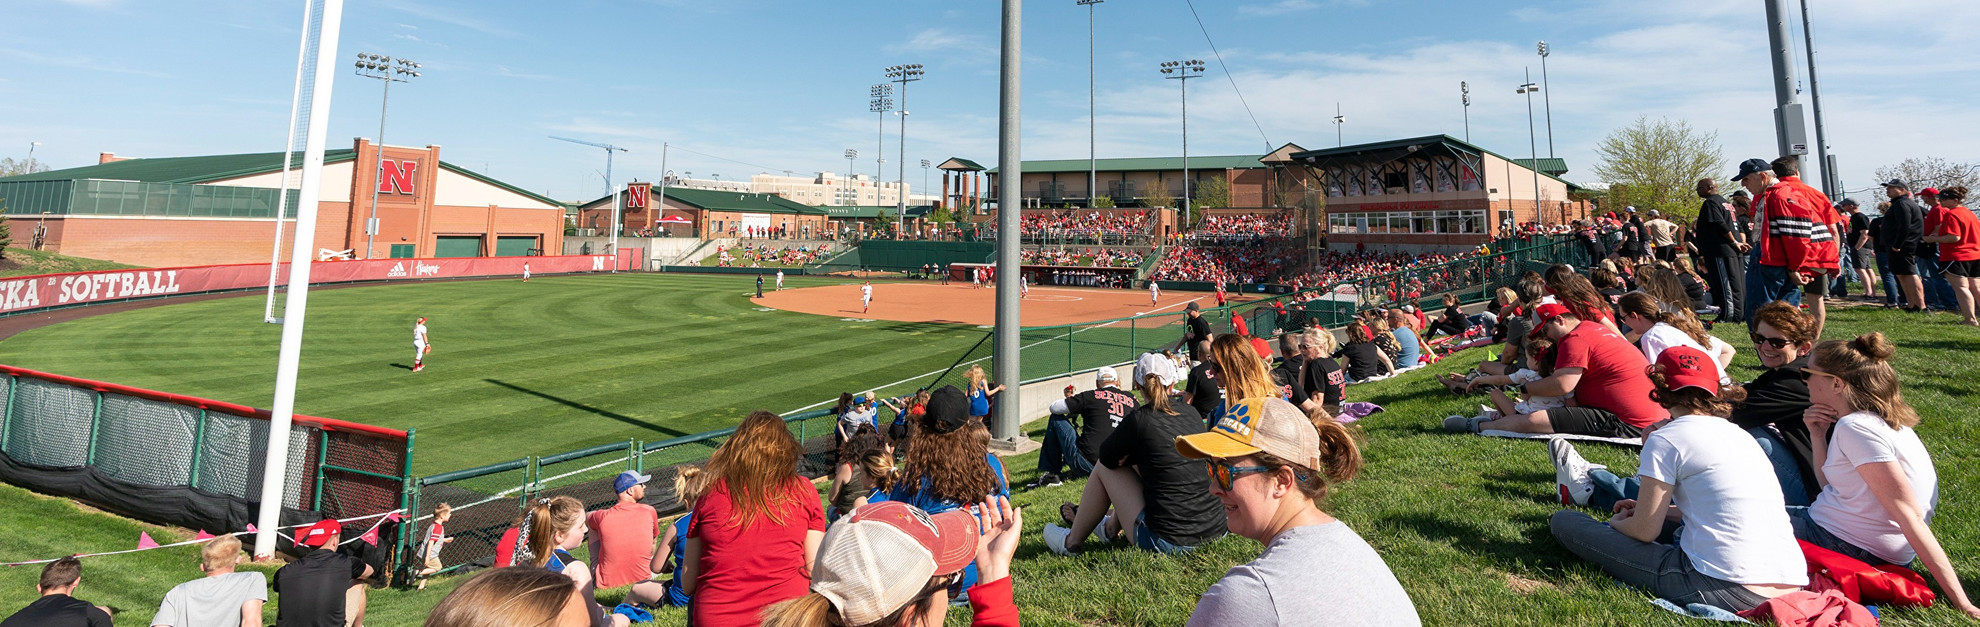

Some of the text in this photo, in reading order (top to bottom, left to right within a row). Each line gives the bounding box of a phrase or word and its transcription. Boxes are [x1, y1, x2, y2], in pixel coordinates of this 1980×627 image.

[378, 159, 417, 194] N
[628, 185, 645, 207] N
[592, 256, 605, 270] N
[0, 270, 180, 311] KA SOFTBALL
[1107, 399, 1124, 417] 30
